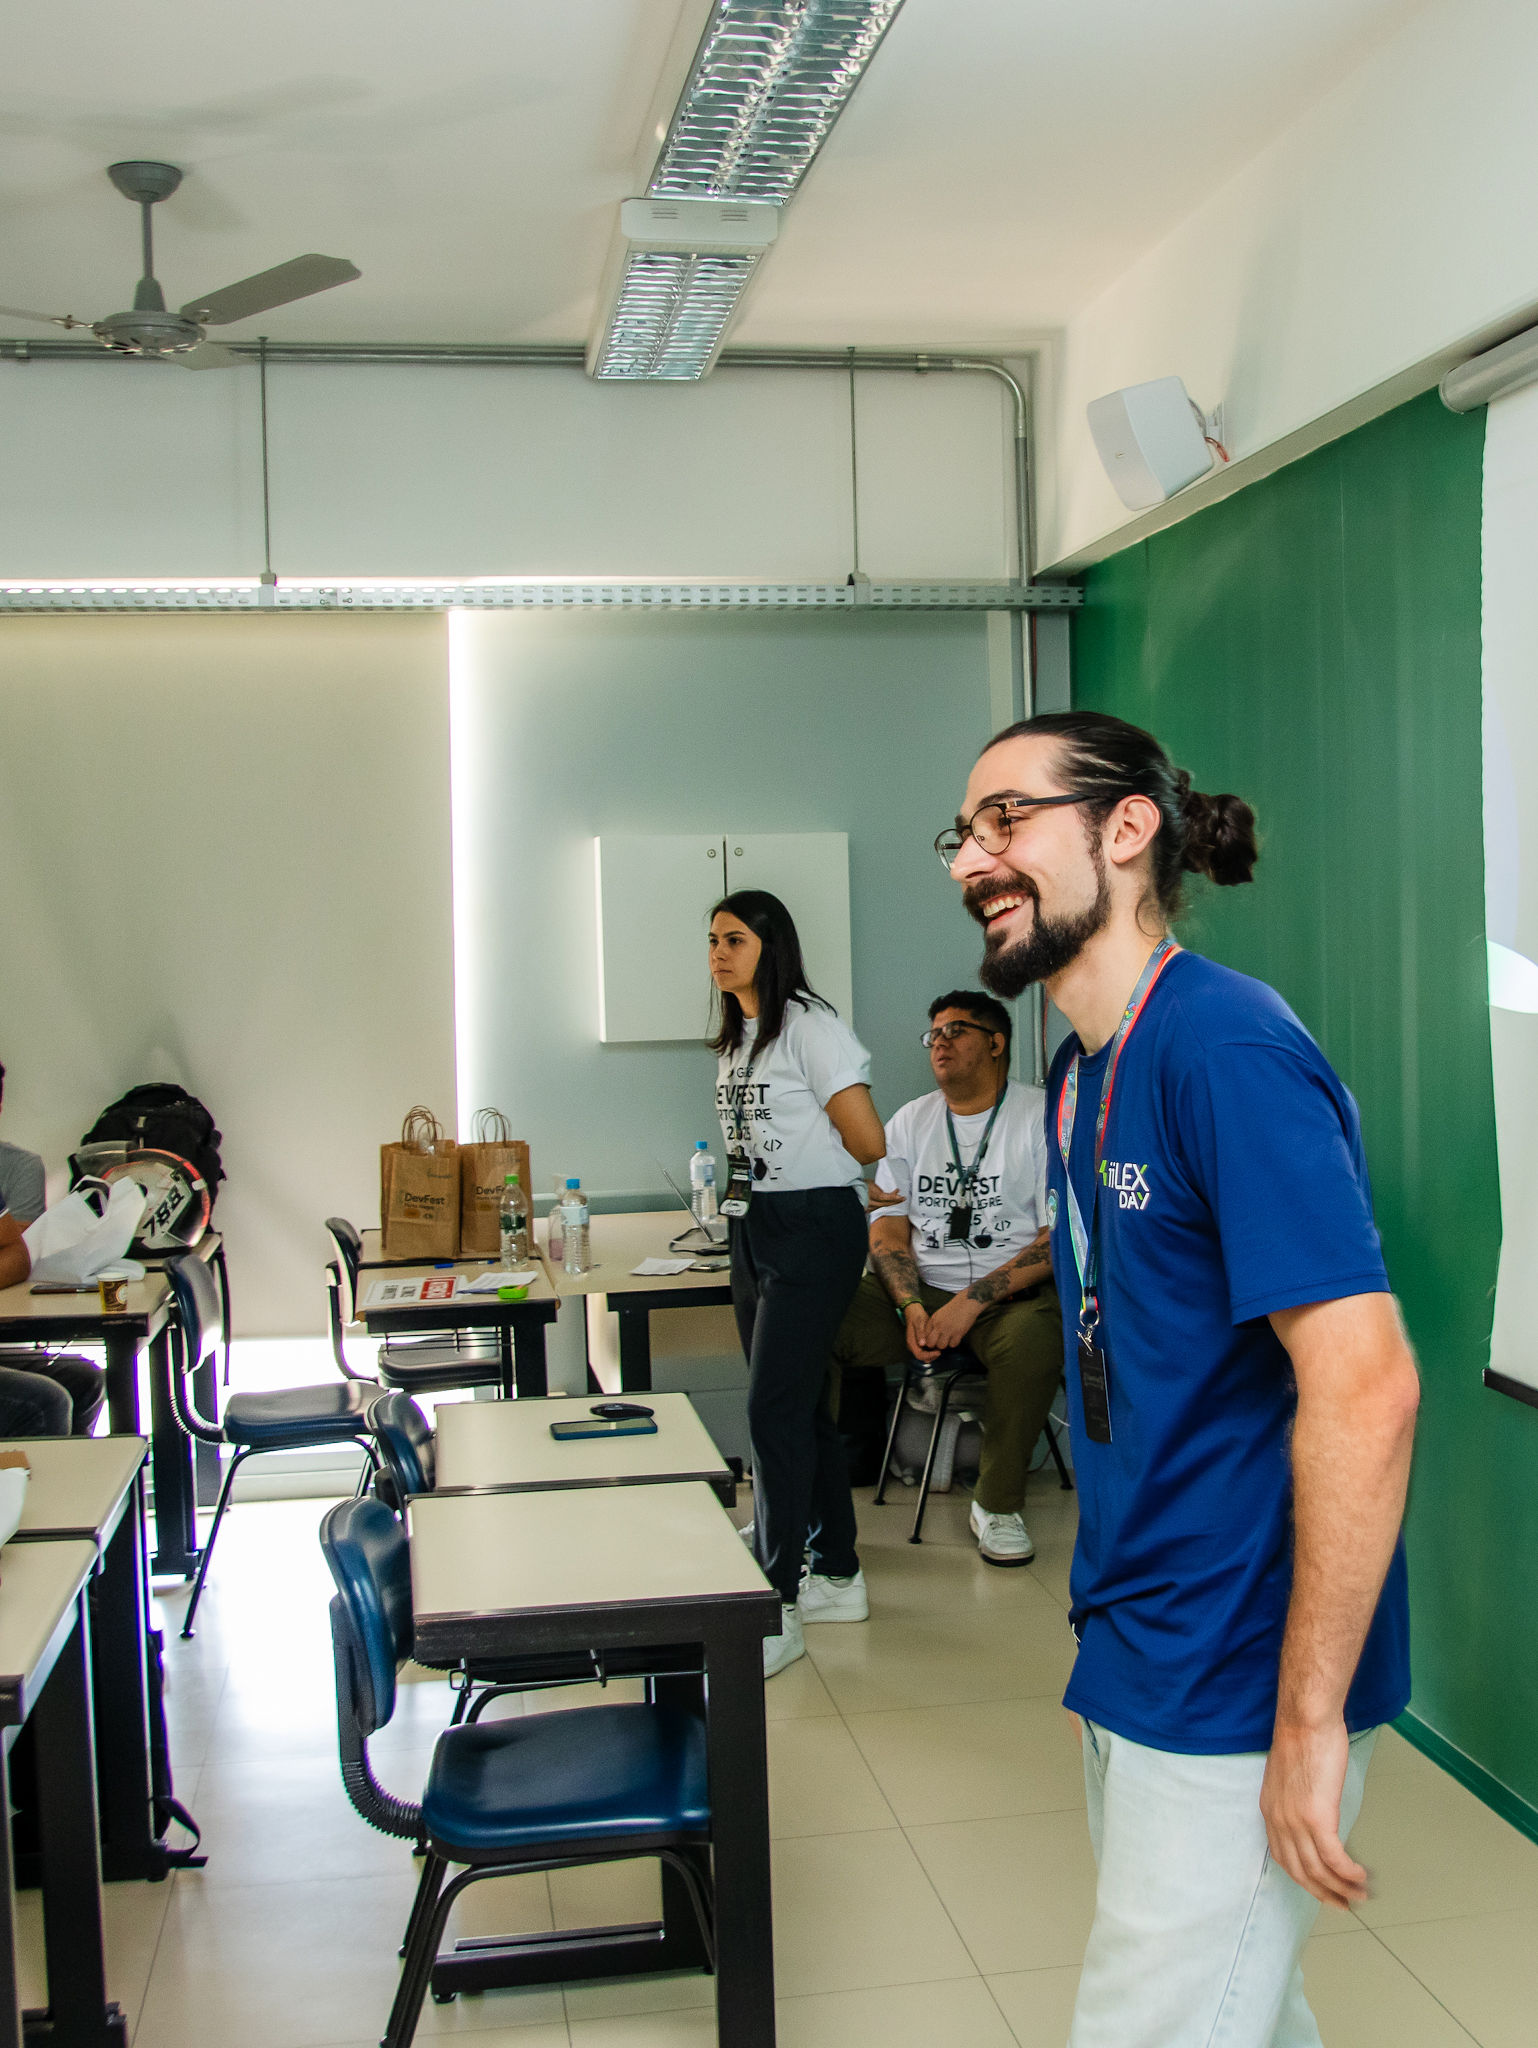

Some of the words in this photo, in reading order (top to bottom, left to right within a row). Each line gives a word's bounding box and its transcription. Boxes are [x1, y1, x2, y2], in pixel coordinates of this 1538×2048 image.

[404, 1192, 446, 1205] DevFest
[918, 1196, 958, 1209] PORTO
[1119, 1190, 1150, 1210] DAY
